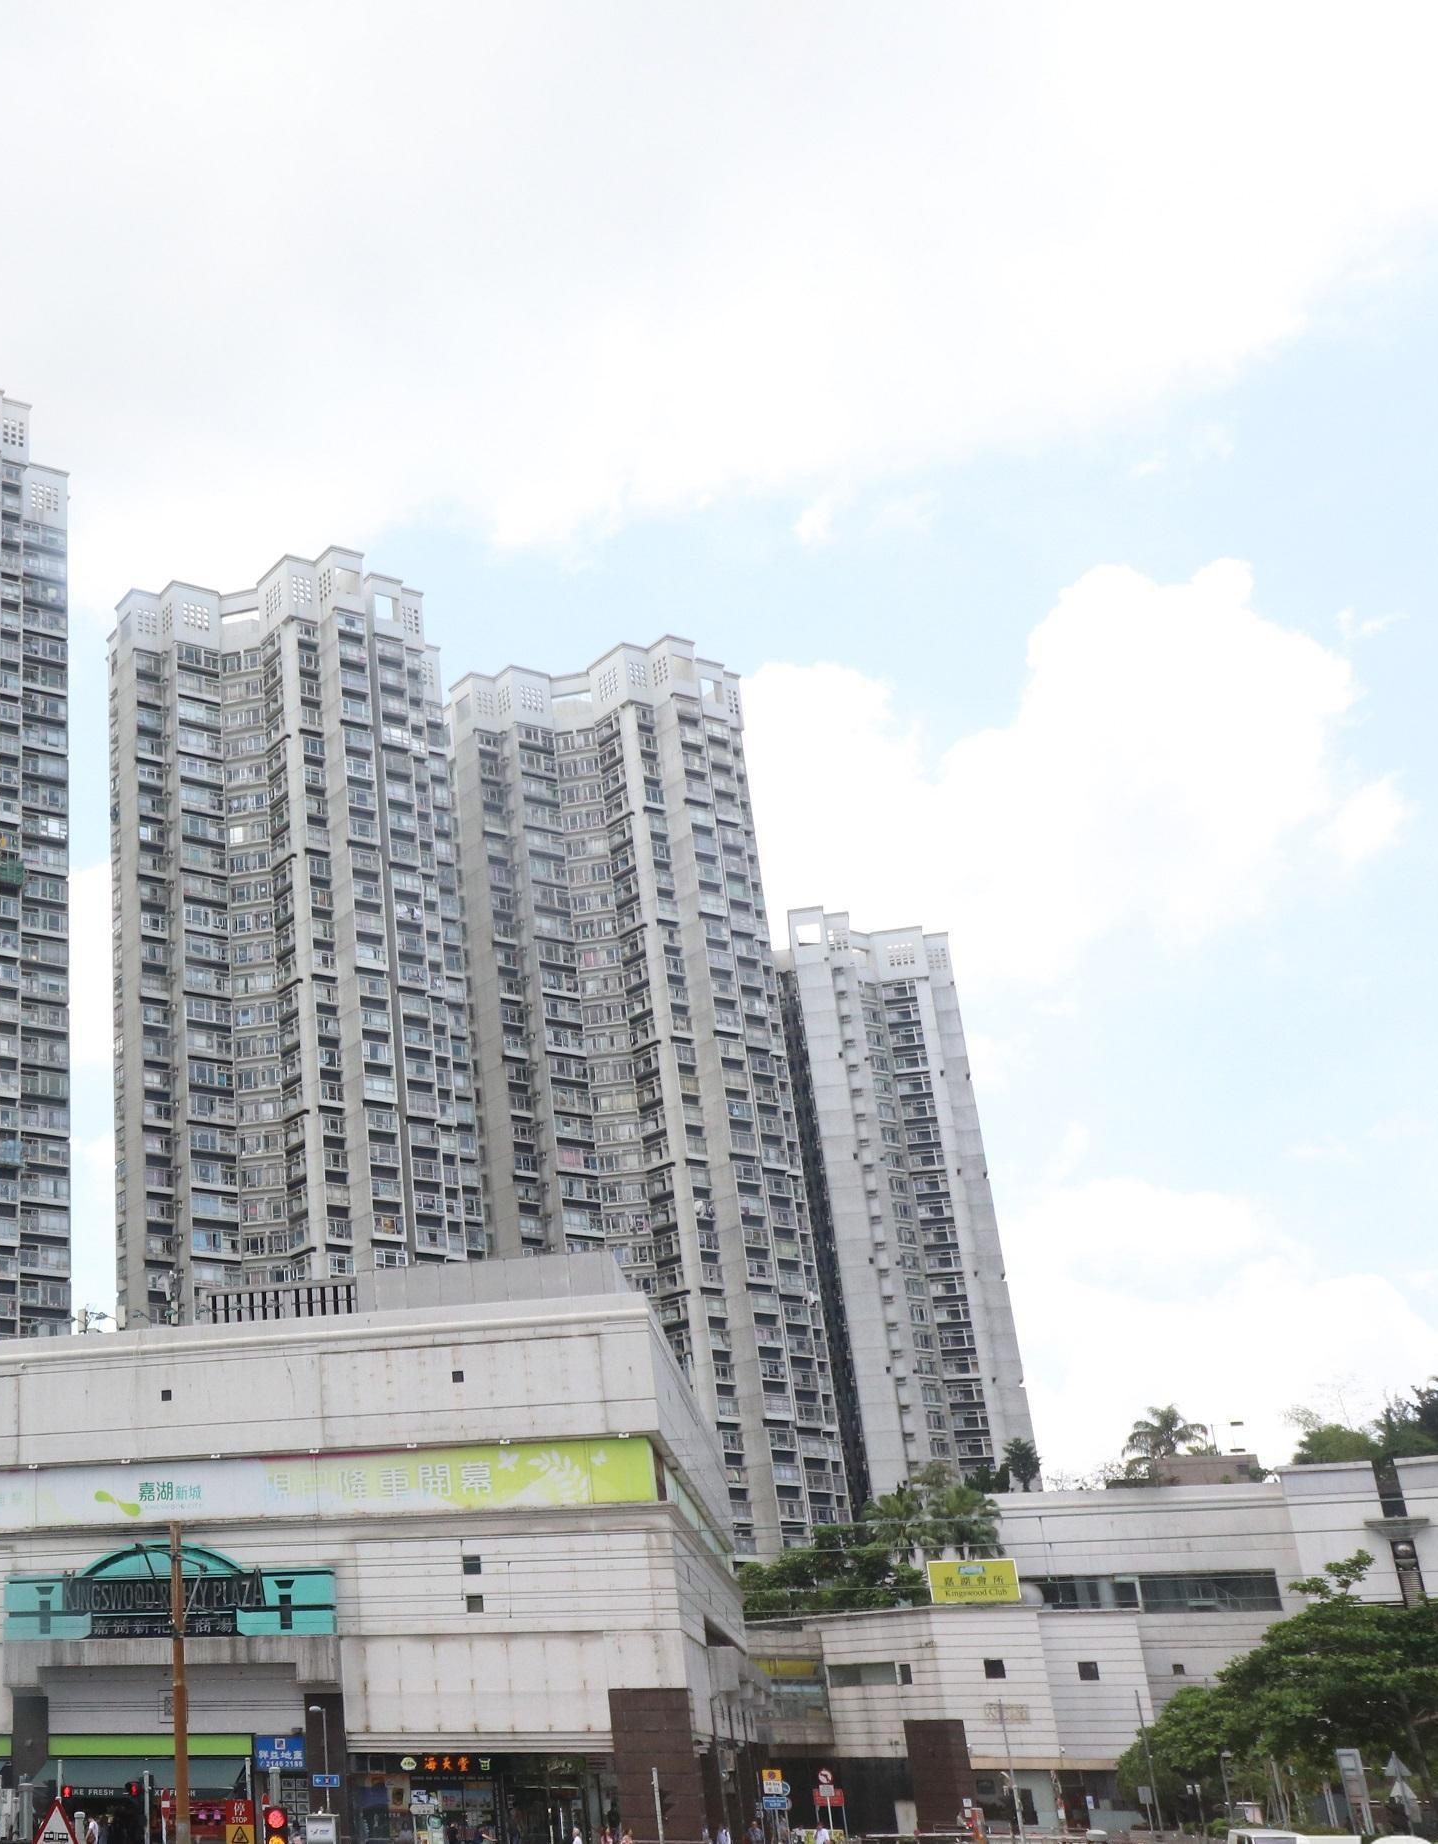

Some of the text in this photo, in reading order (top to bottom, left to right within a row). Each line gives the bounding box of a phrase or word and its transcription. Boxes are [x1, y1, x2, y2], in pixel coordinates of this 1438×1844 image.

[63, 1568, 265, 1610] KINGSWOOD RHLY PLAZA
[945, 1588, 1007, 1598] Kingswood Club
[88, 1788, 114, 1796] FRESH
[231, 1816, 248, 1824] STOP
